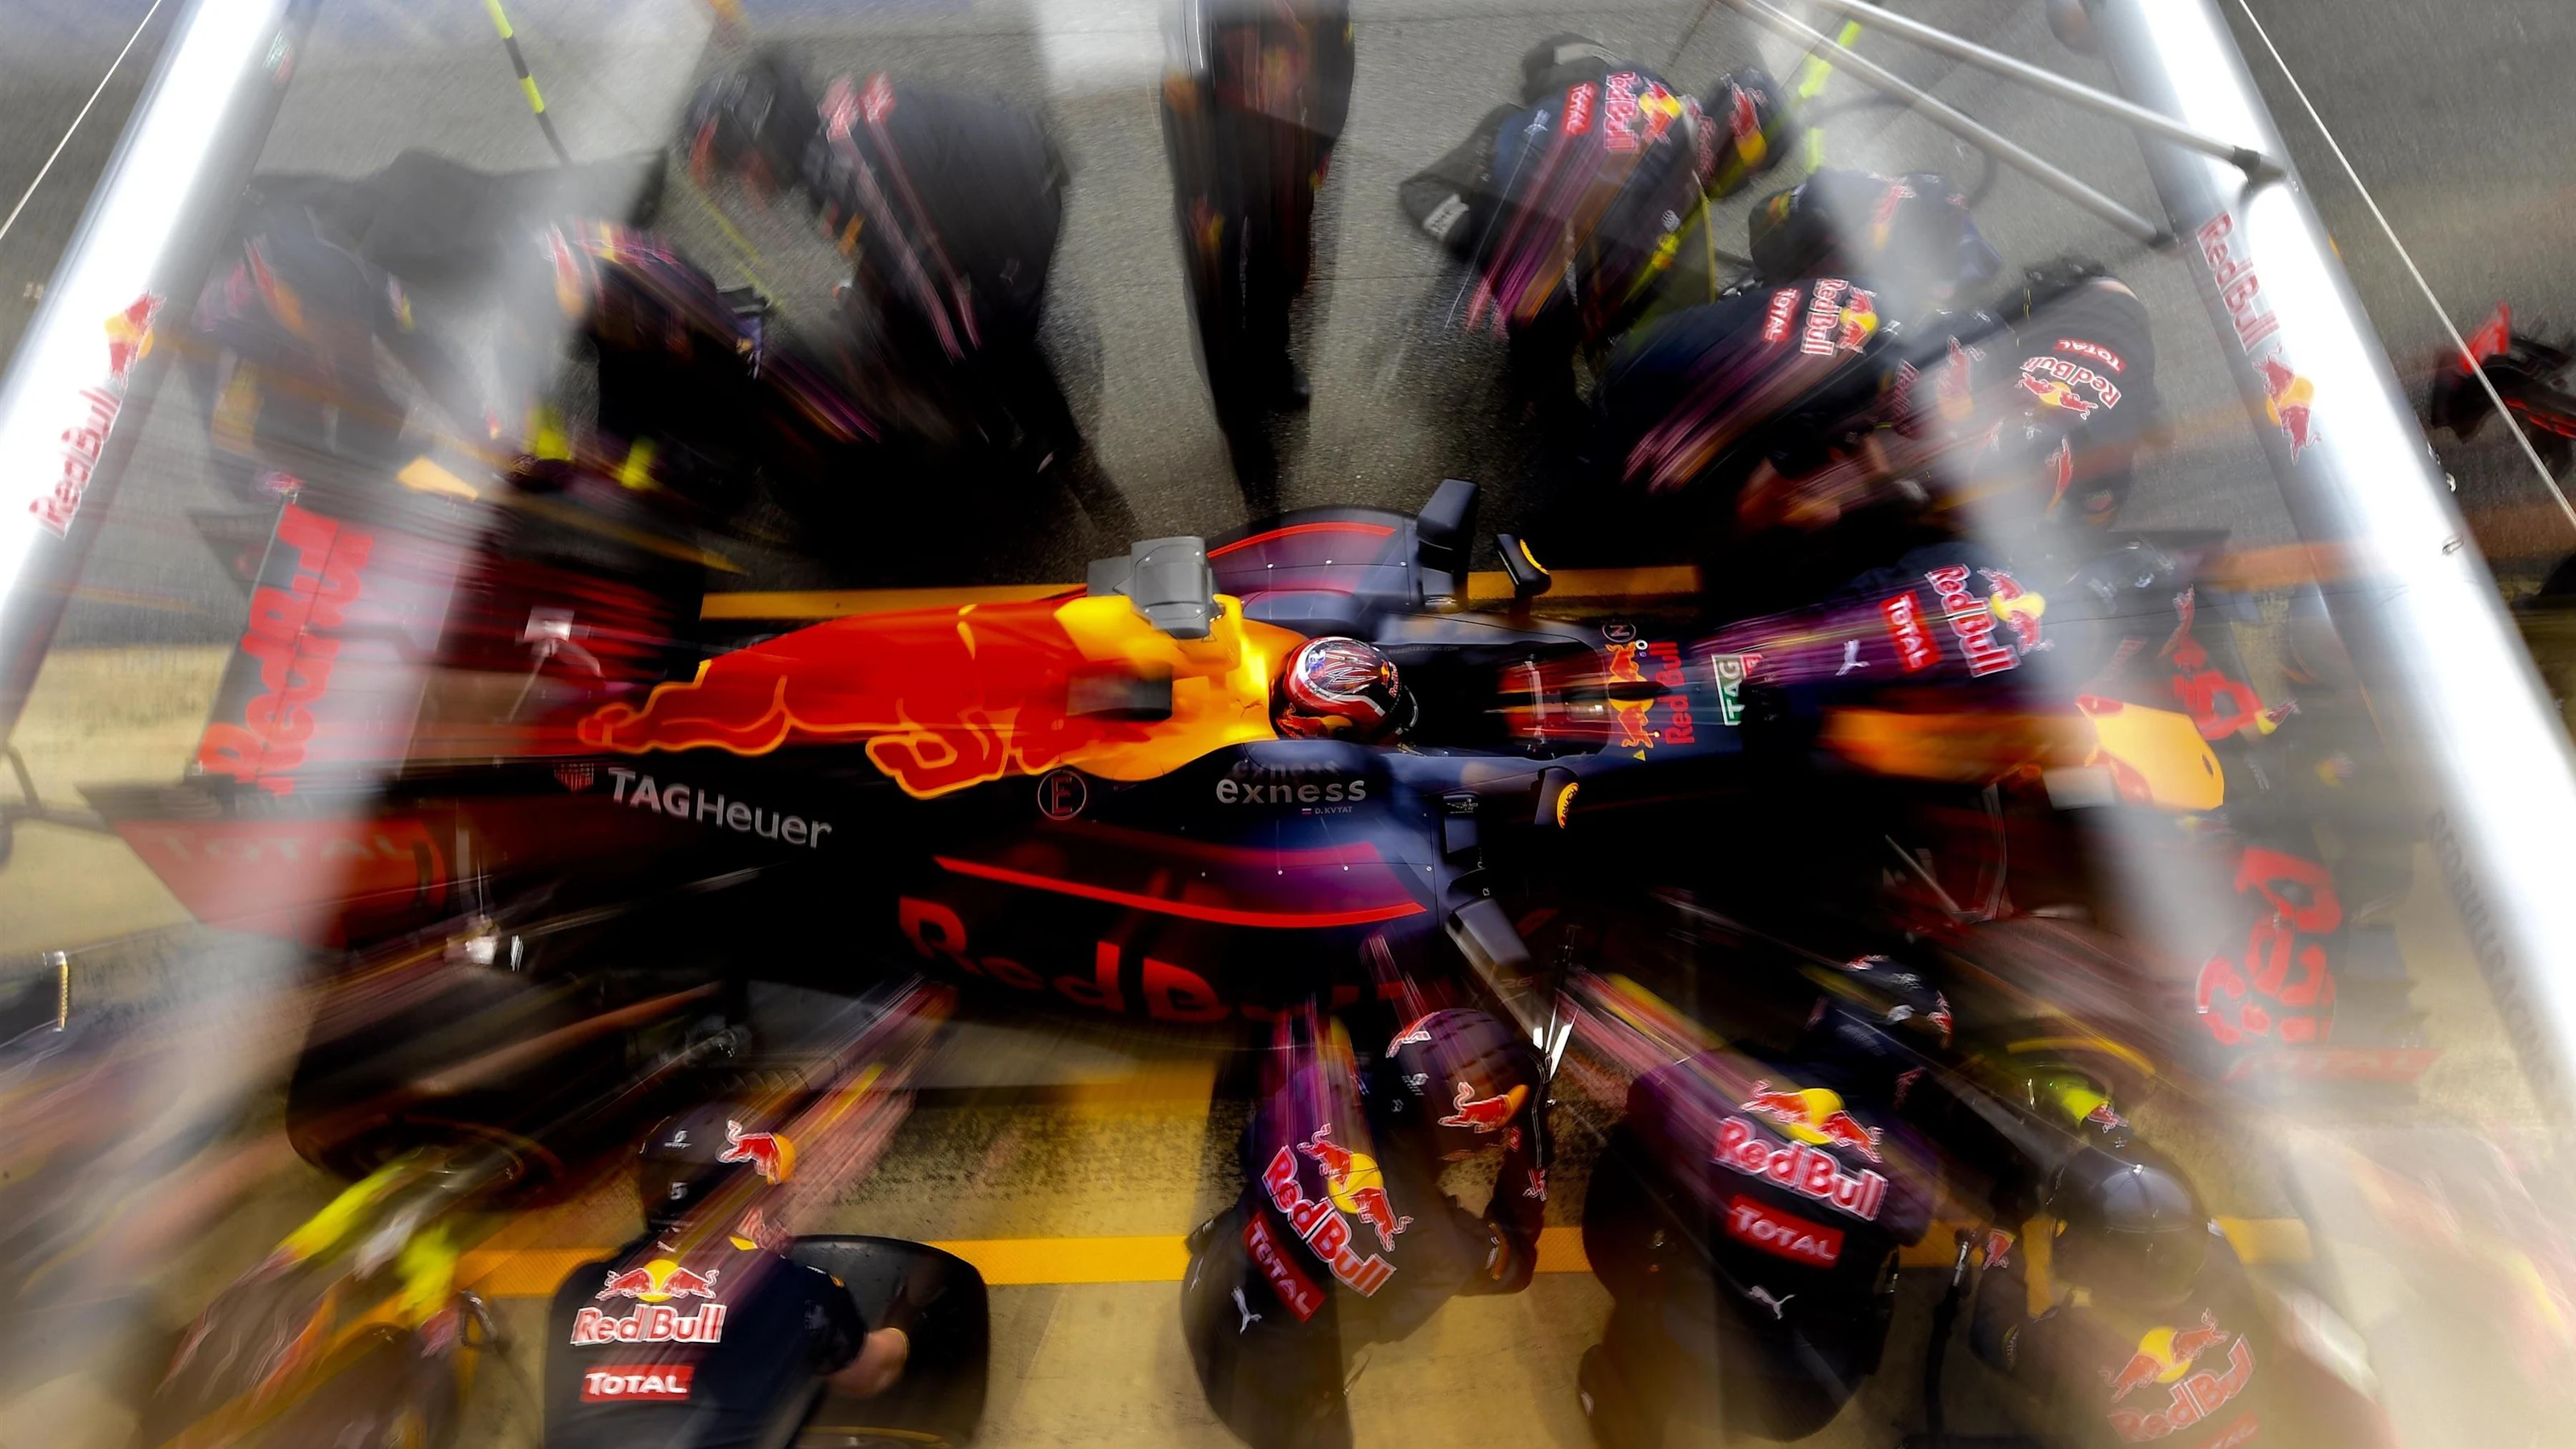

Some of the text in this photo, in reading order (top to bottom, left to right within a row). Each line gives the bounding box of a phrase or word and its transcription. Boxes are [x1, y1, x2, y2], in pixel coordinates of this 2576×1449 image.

[1765, 287, 1798, 341] TOTAL
[2057, 339, 2121, 371] TOTAL
[1888, 594, 1930, 669] TOTAL
[1649, 641, 1695, 745] Red Bull
[1216, 777, 1367, 804] exness
[1736, 1204, 1838, 1261] TOTAL
[1249, 1220, 1311, 1315] TOTAL
[585, 1372, 688, 1396] TOTAL
